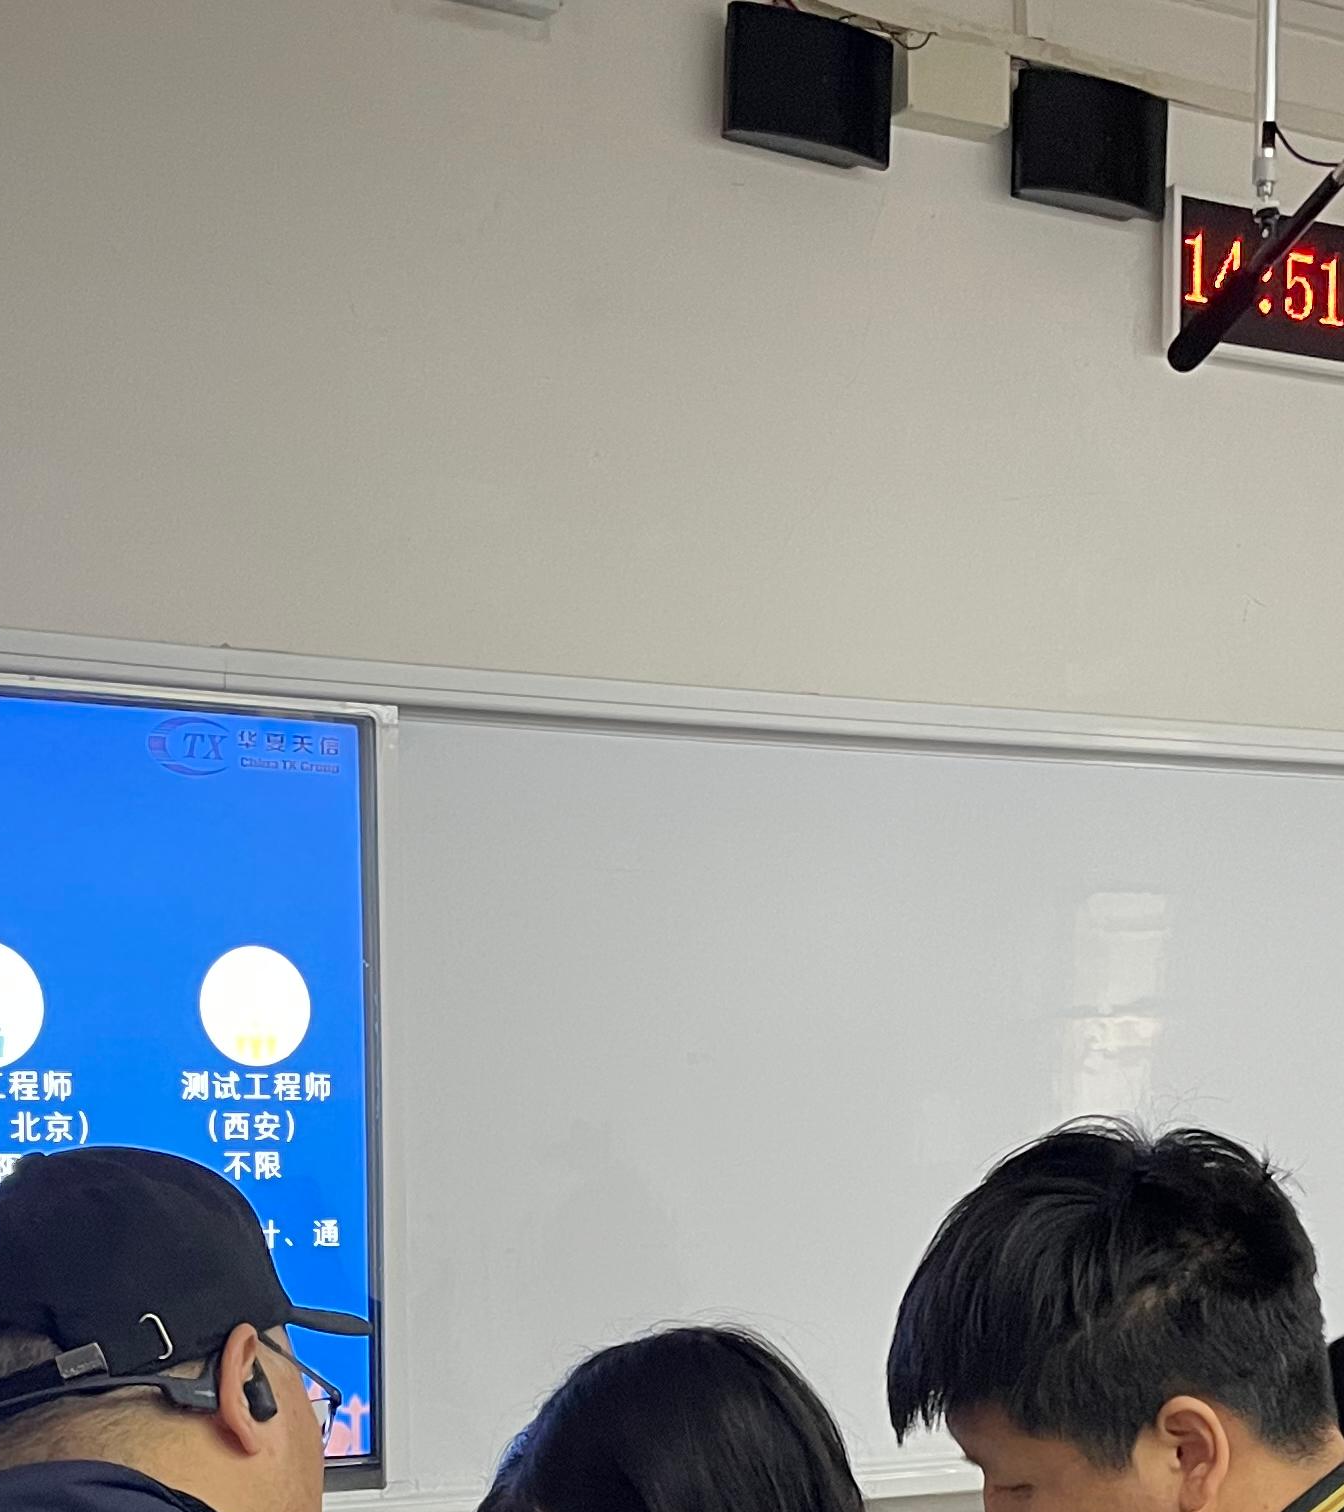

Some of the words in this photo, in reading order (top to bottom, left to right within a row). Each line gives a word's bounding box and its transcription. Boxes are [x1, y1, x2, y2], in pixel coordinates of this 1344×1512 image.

[181, 1069, 332, 1101] 测试工程师
[207, 1109, 296, 1143] （西安）
[223, 1151, 283, 1181] 不限
